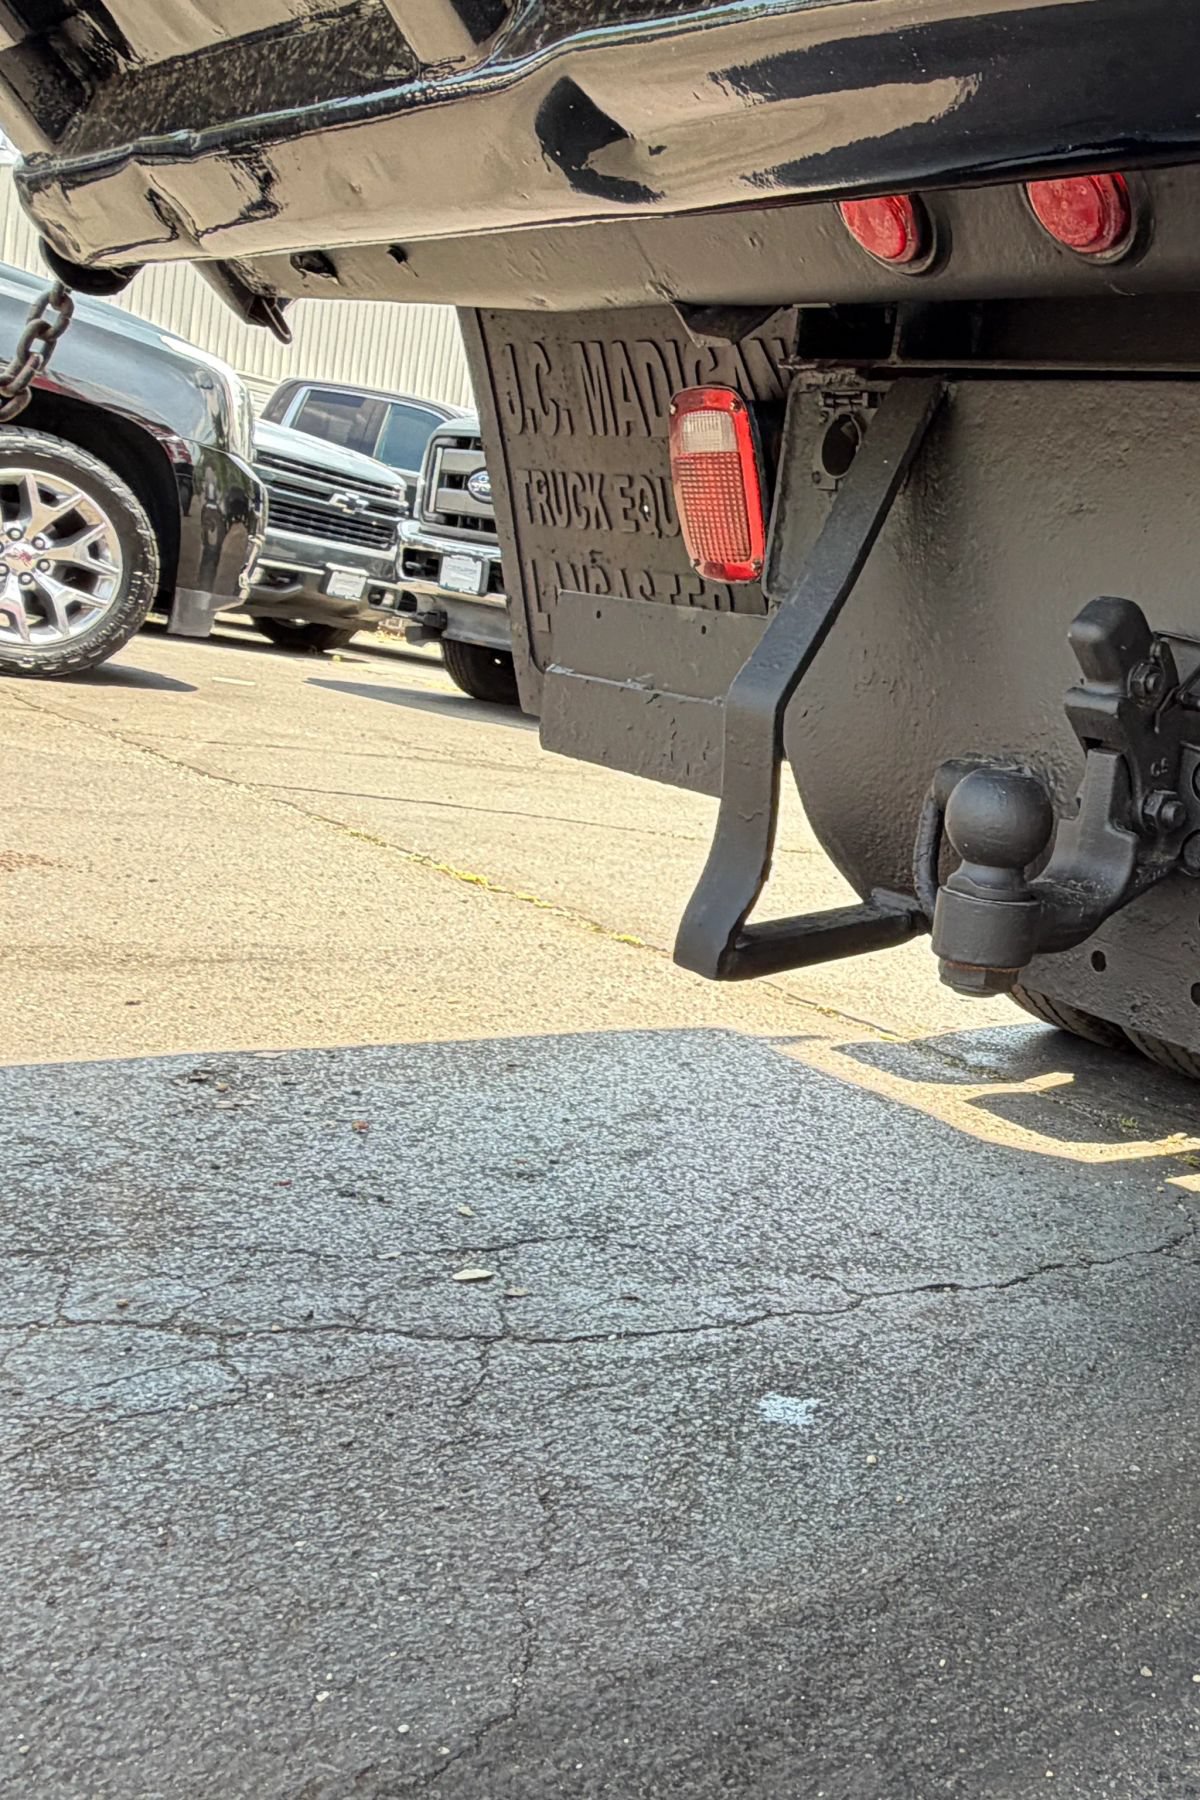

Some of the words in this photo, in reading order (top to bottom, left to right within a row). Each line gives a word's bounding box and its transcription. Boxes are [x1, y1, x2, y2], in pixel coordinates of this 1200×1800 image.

[502, 338, 577, 438] J.C.
[514, 467, 613, 533] TRUCK
[613, 472, 686, 540] EQU
